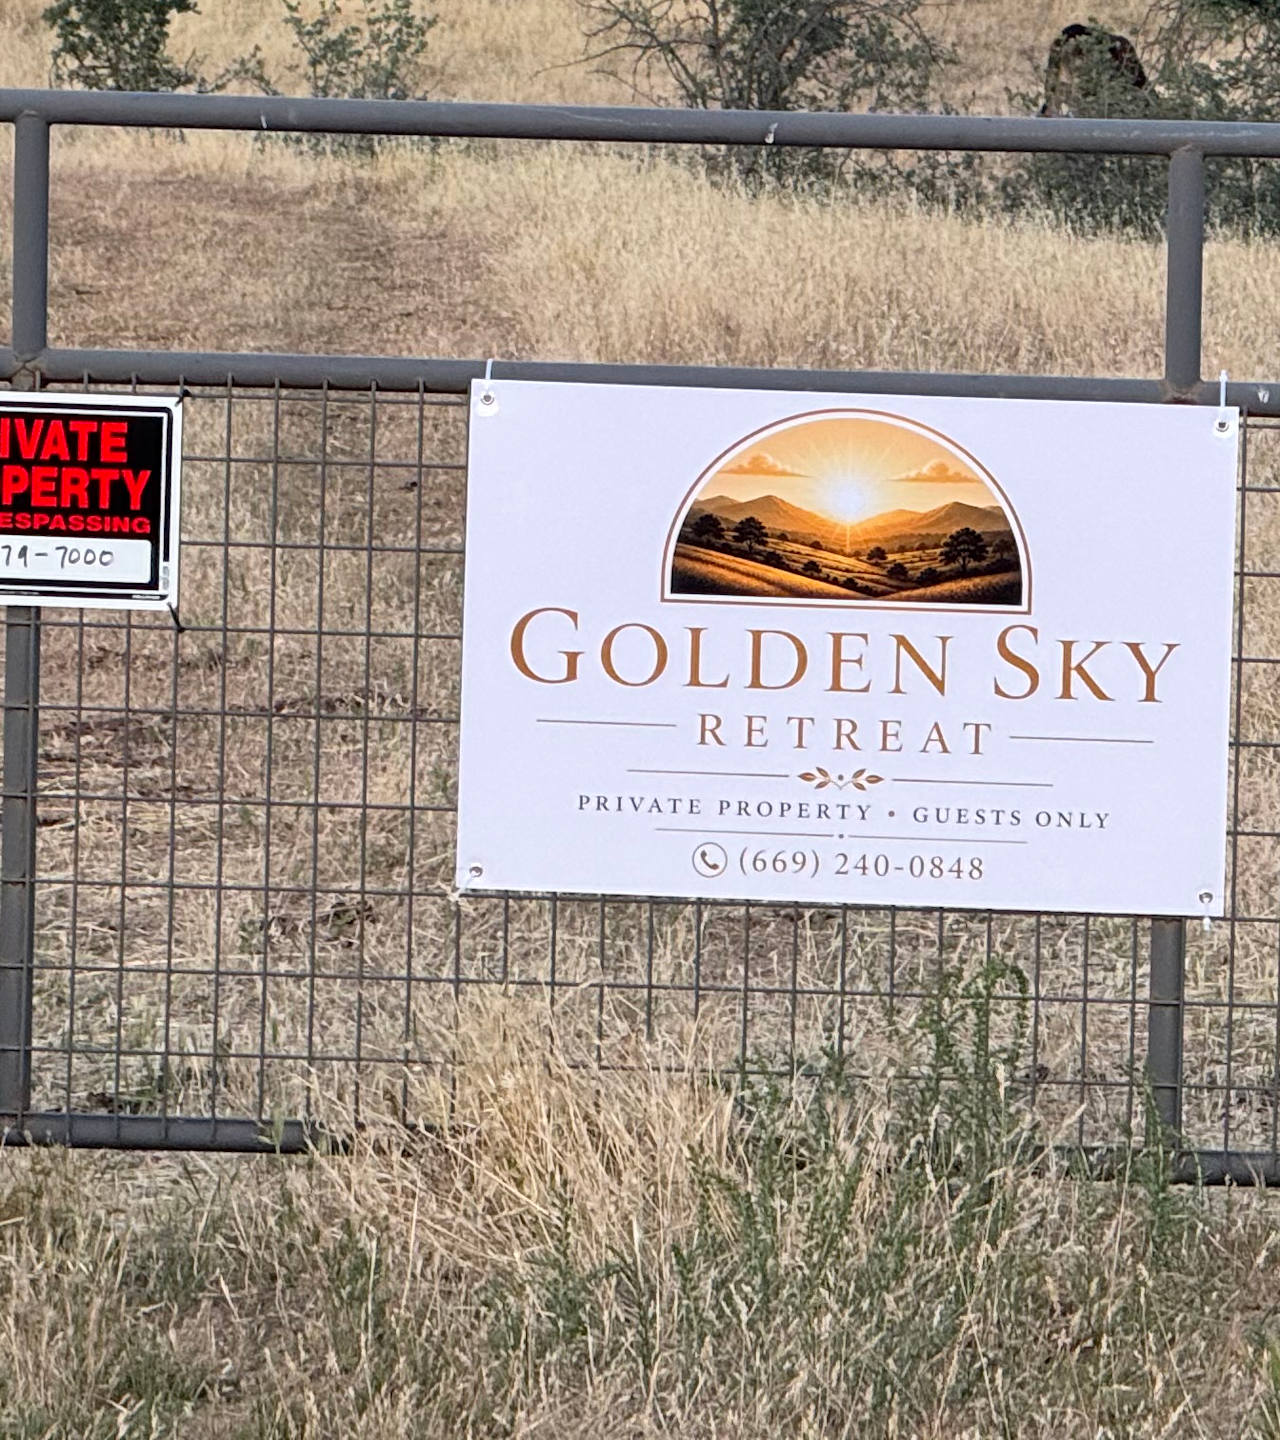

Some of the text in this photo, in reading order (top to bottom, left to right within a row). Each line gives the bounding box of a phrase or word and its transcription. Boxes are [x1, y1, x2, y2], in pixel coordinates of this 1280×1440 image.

[510, 607, 1182, 703] GOLDEN SKY
[696, 713, 992, 755] RETREAT
[578, 794, 1111, 829] PRIVATE PROPERTY GUESTS ONLY
[739, 846, 984, 880] (669) 240-0848
